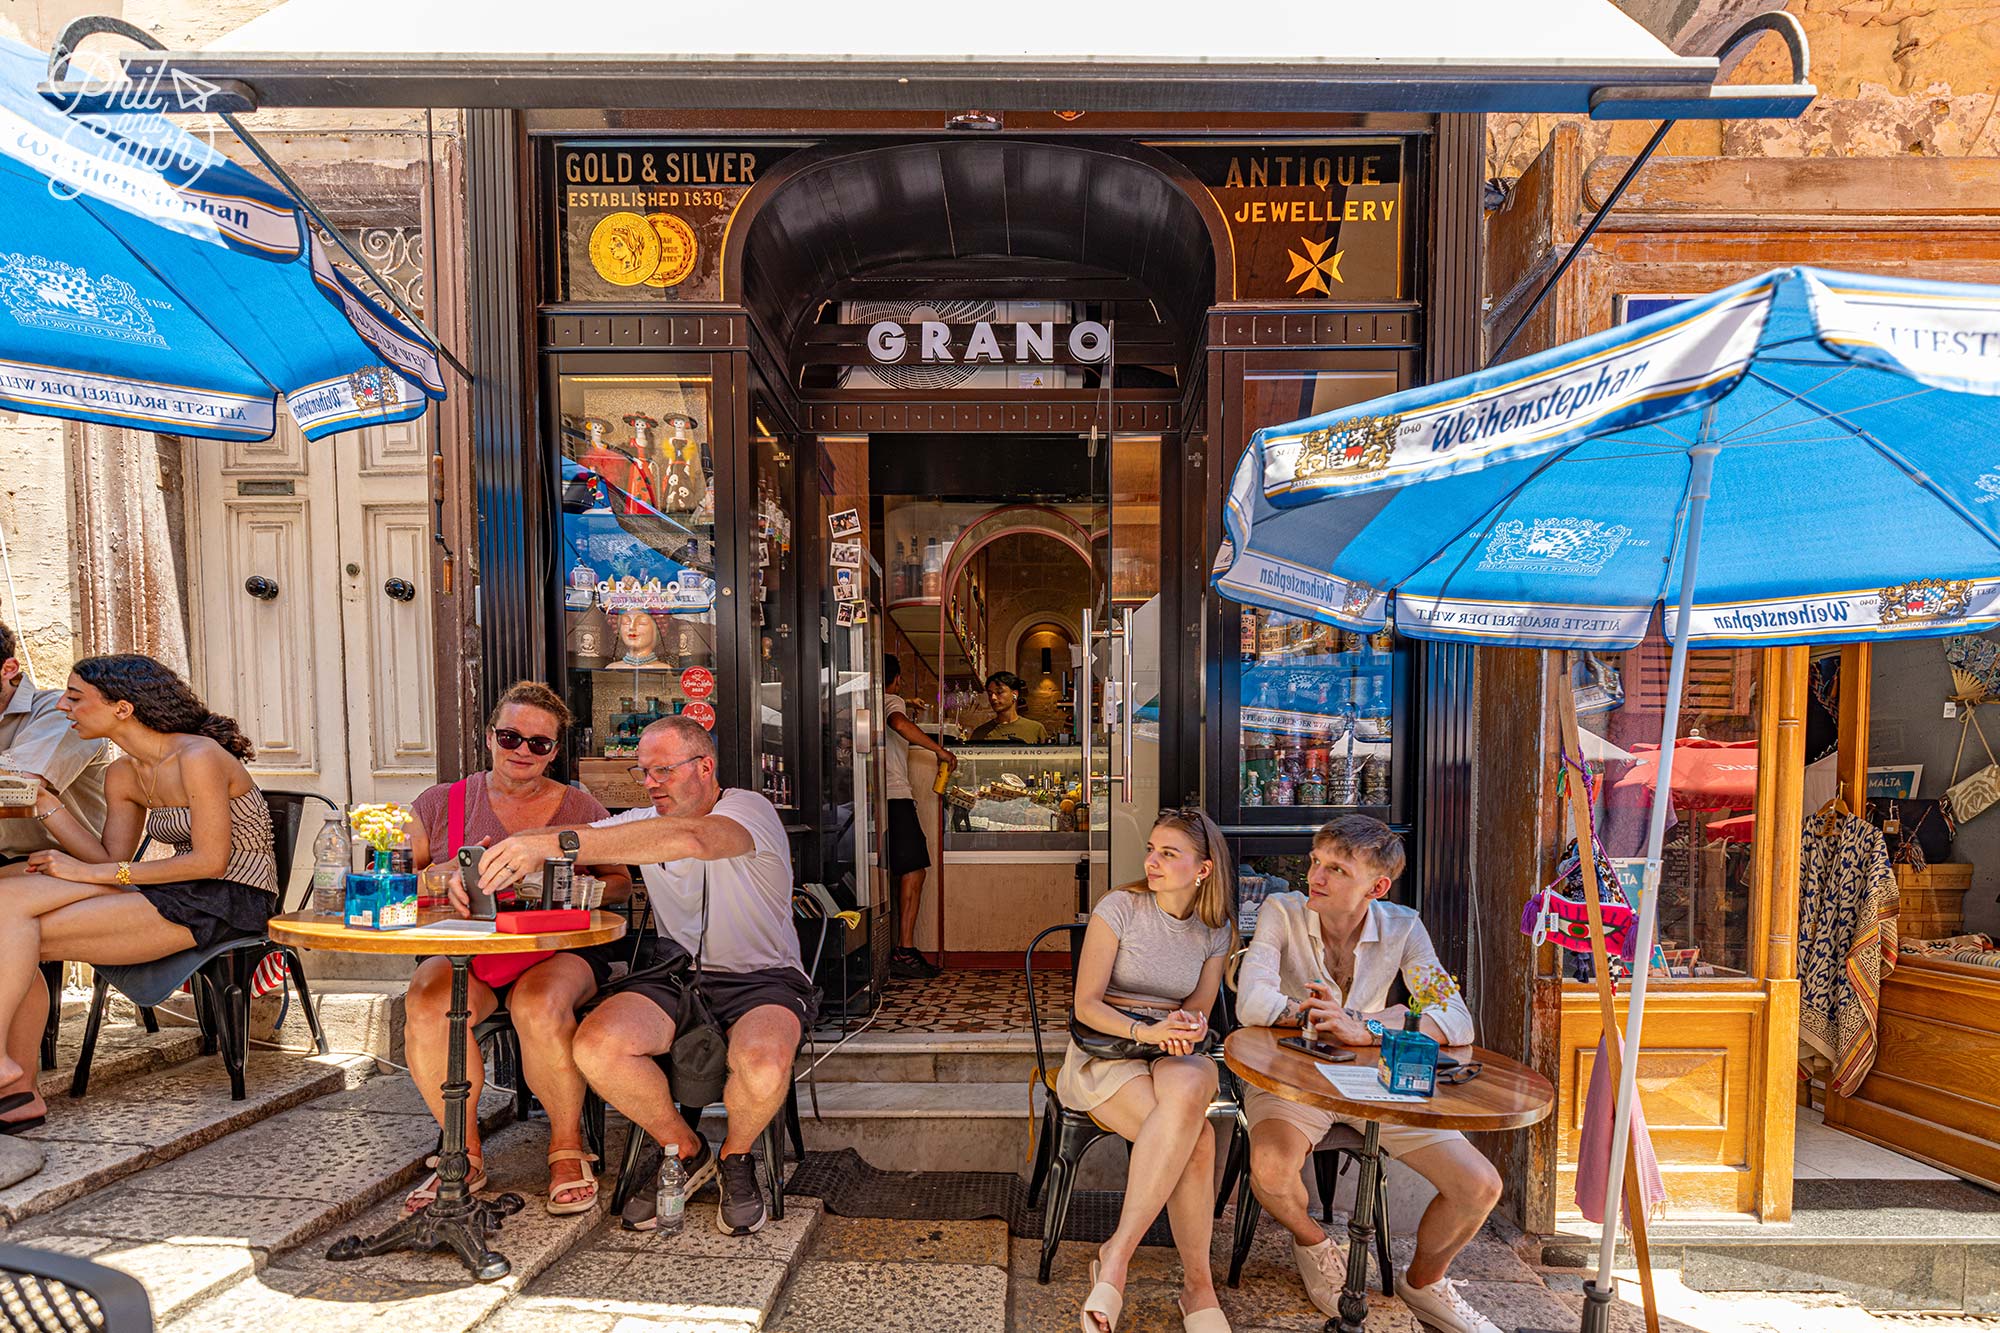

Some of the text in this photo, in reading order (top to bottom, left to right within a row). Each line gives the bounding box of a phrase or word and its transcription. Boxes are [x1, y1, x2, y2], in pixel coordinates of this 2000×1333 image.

[565, 152, 756, 184] GOLD & SILVER
[1225, 155, 1382, 192] ANTIQUE
[568, 191, 724, 209] ESTABLISHED 1830
[1234, 200, 1395, 223] JEWELLERY
[867, 320, 1110, 364] GRANO
[1431, 360, 1650, 453] Weihenstephan
[1398, 423, 1422, 436] 1040
[597, 580, 681, 594] GRANO
[1868, 777, 1902, 788] MALTA
[1618, 872, 1638, 886] LTA
